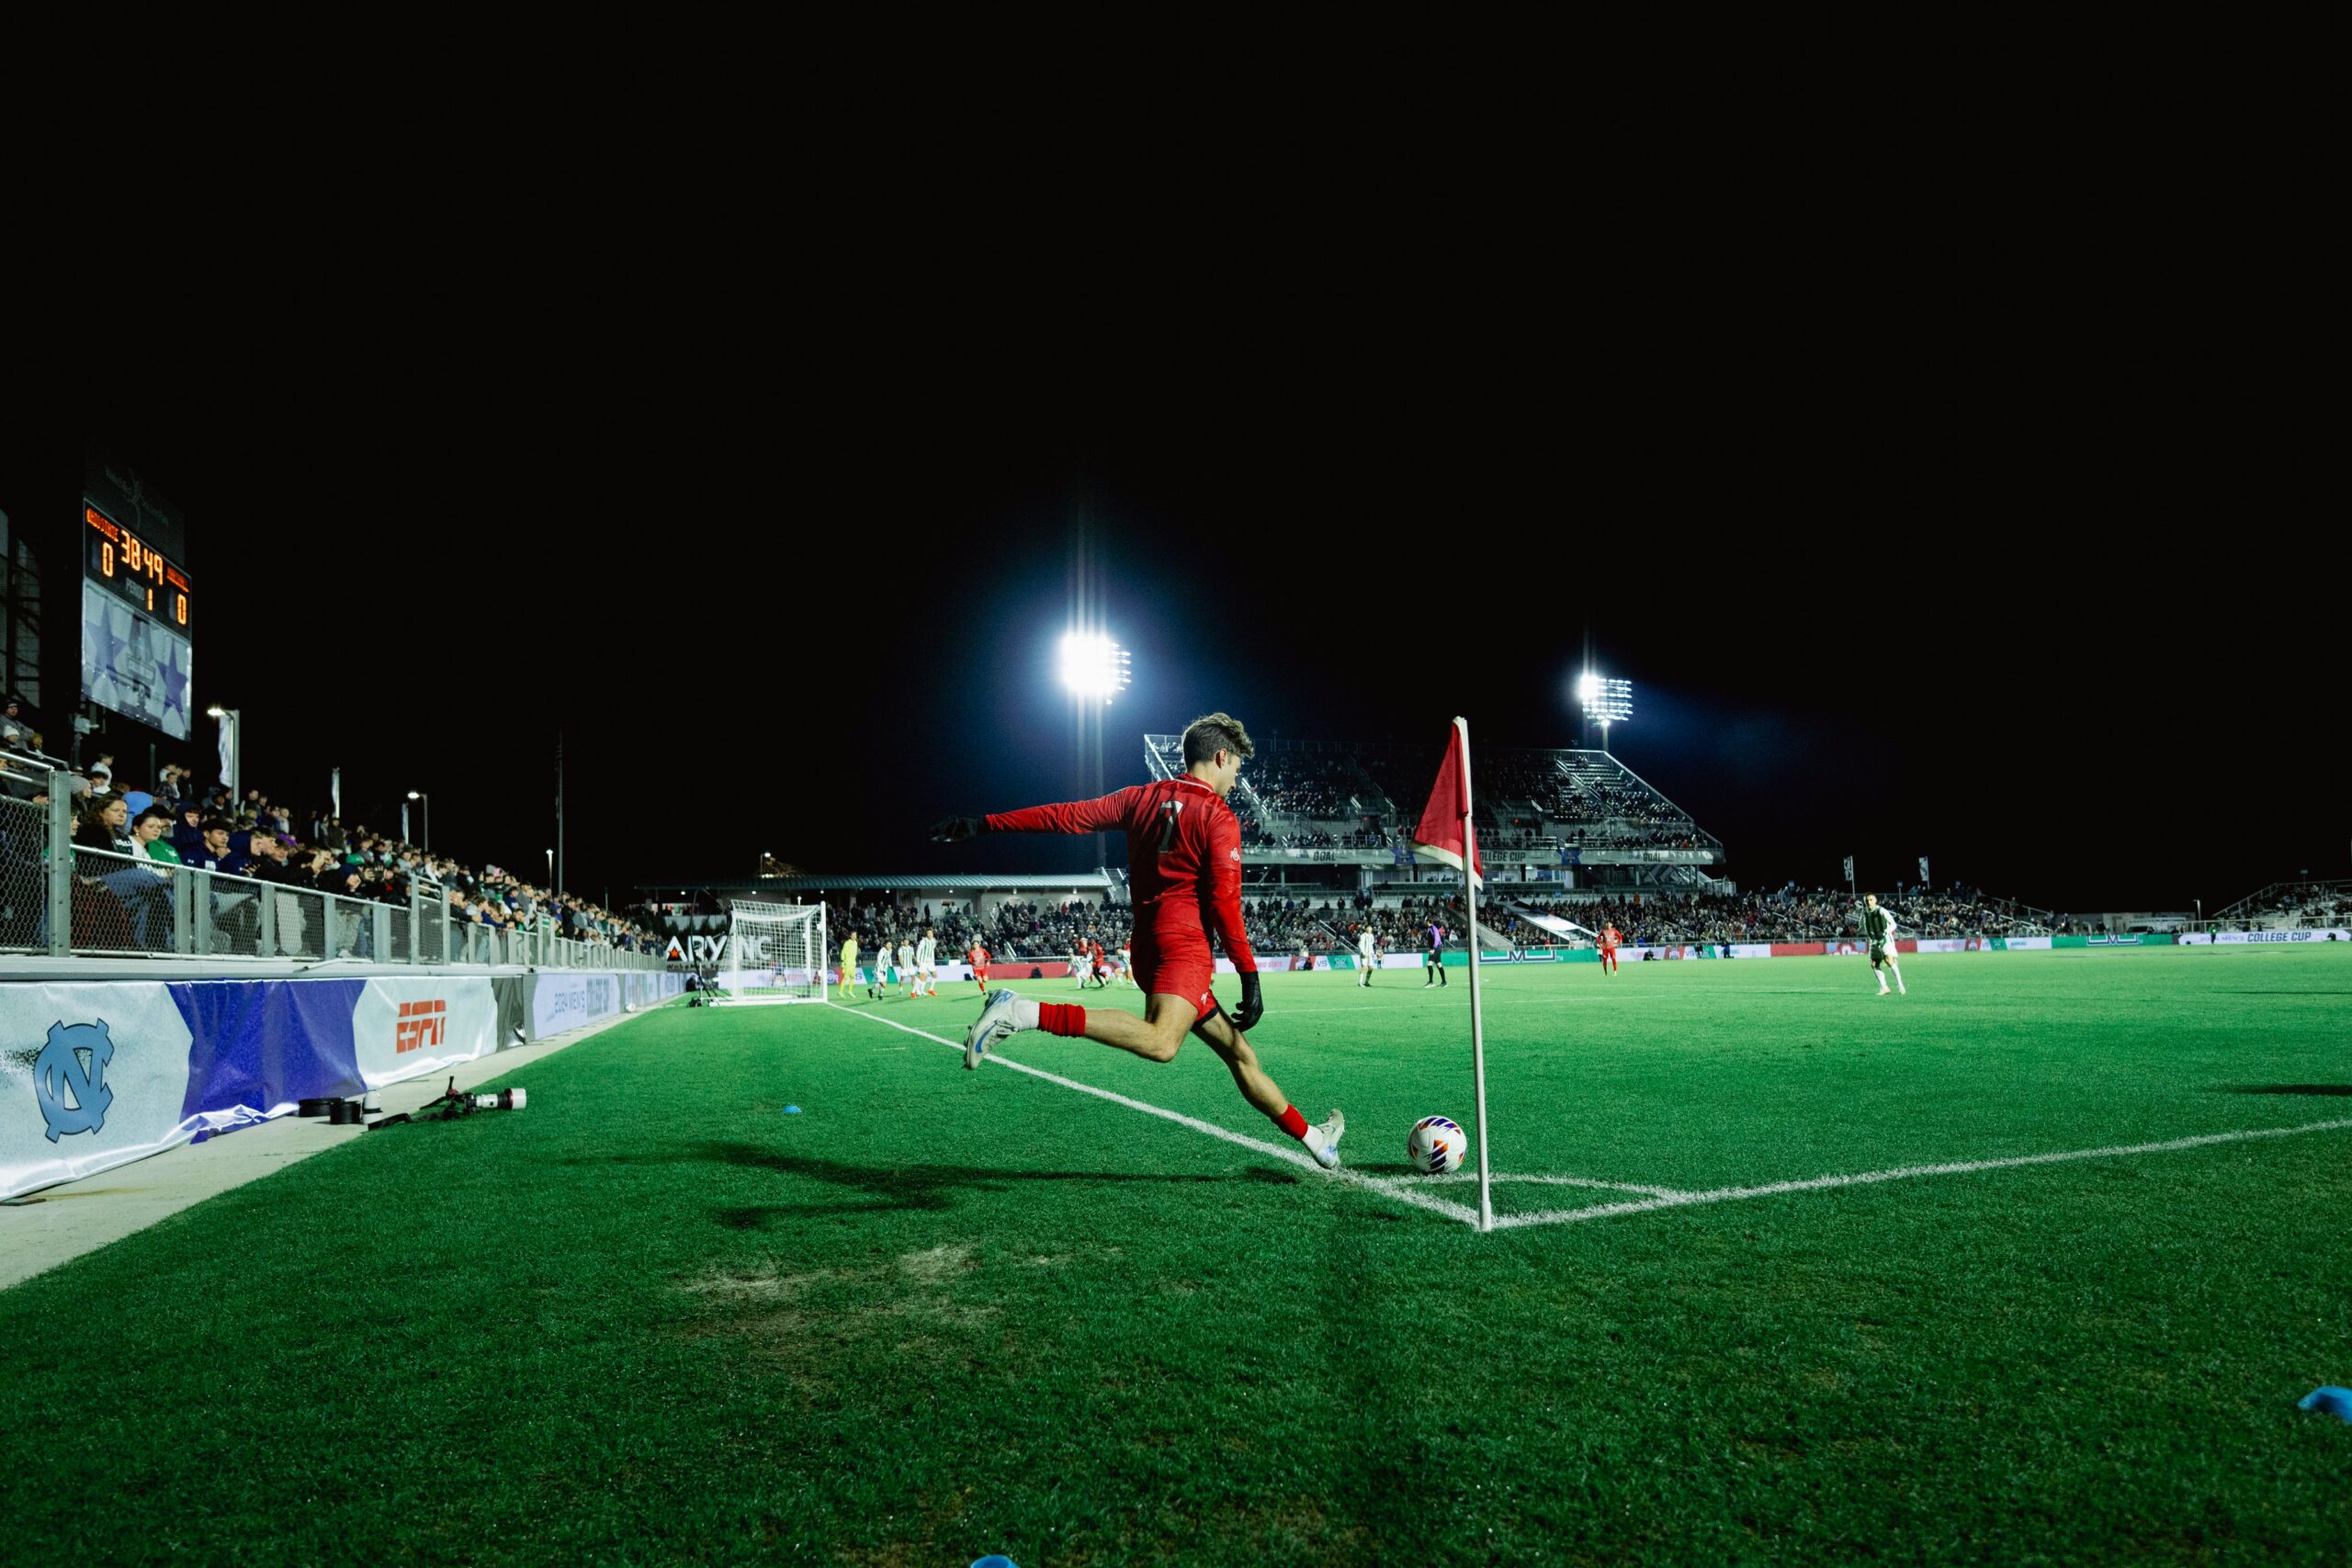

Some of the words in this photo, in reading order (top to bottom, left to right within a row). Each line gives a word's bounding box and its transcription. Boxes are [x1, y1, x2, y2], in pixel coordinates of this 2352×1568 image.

[102, 542, 114, 577] 0
[147, 588, 153, 611] 1
[176, 593, 187, 625] 0
[1479, 851, 1507, 862] OLLEGE
[1510, 851, 1525, 862] CUP
[665, 935, 727, 962] ARY
[738, 935, 772, 961] NC
[2247, 932, 2288, 942] COLLEGE
[2290, 931, 2312, 942] CUP
[396, 999, 447, 1055] ESPN
